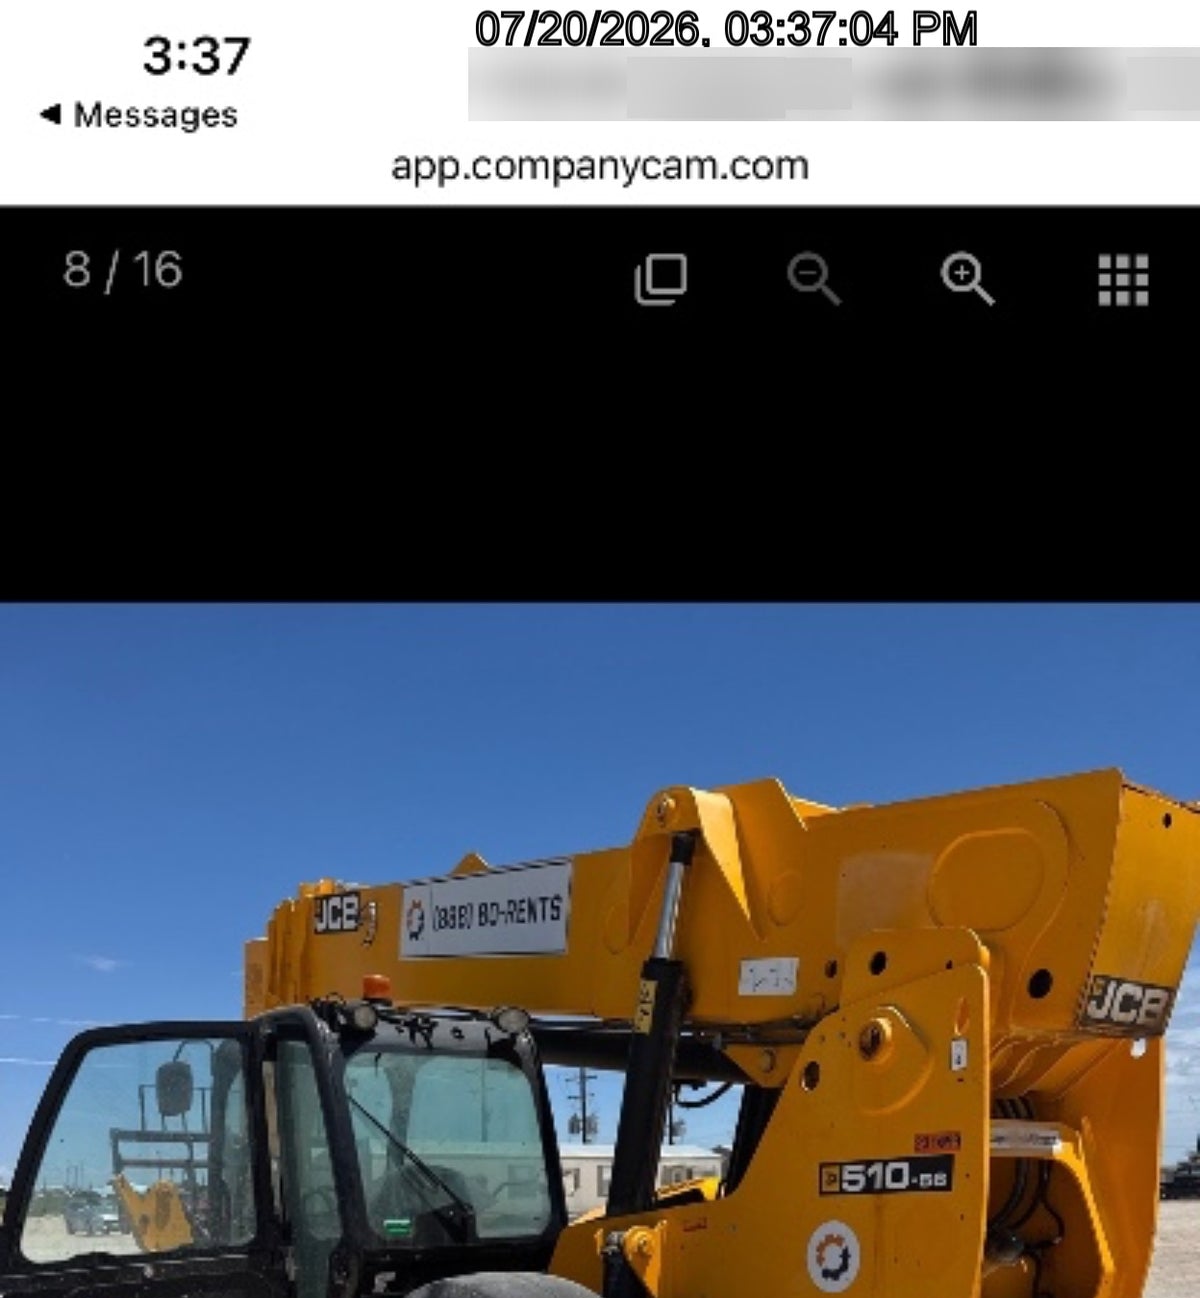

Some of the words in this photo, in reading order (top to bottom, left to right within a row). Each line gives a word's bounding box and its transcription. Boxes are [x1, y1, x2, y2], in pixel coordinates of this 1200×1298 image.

[143, 36, 251, 76] 3:37
[75, 101, 238, 134] Messages
[391, 154, 810, 189] app.companycam.com
[63, 250, 91, 288] 8
[133, 250, 183, 288] 16
[314, 894, 360, 932] JCB
[1086, 979, 1170, 1024] JCB
